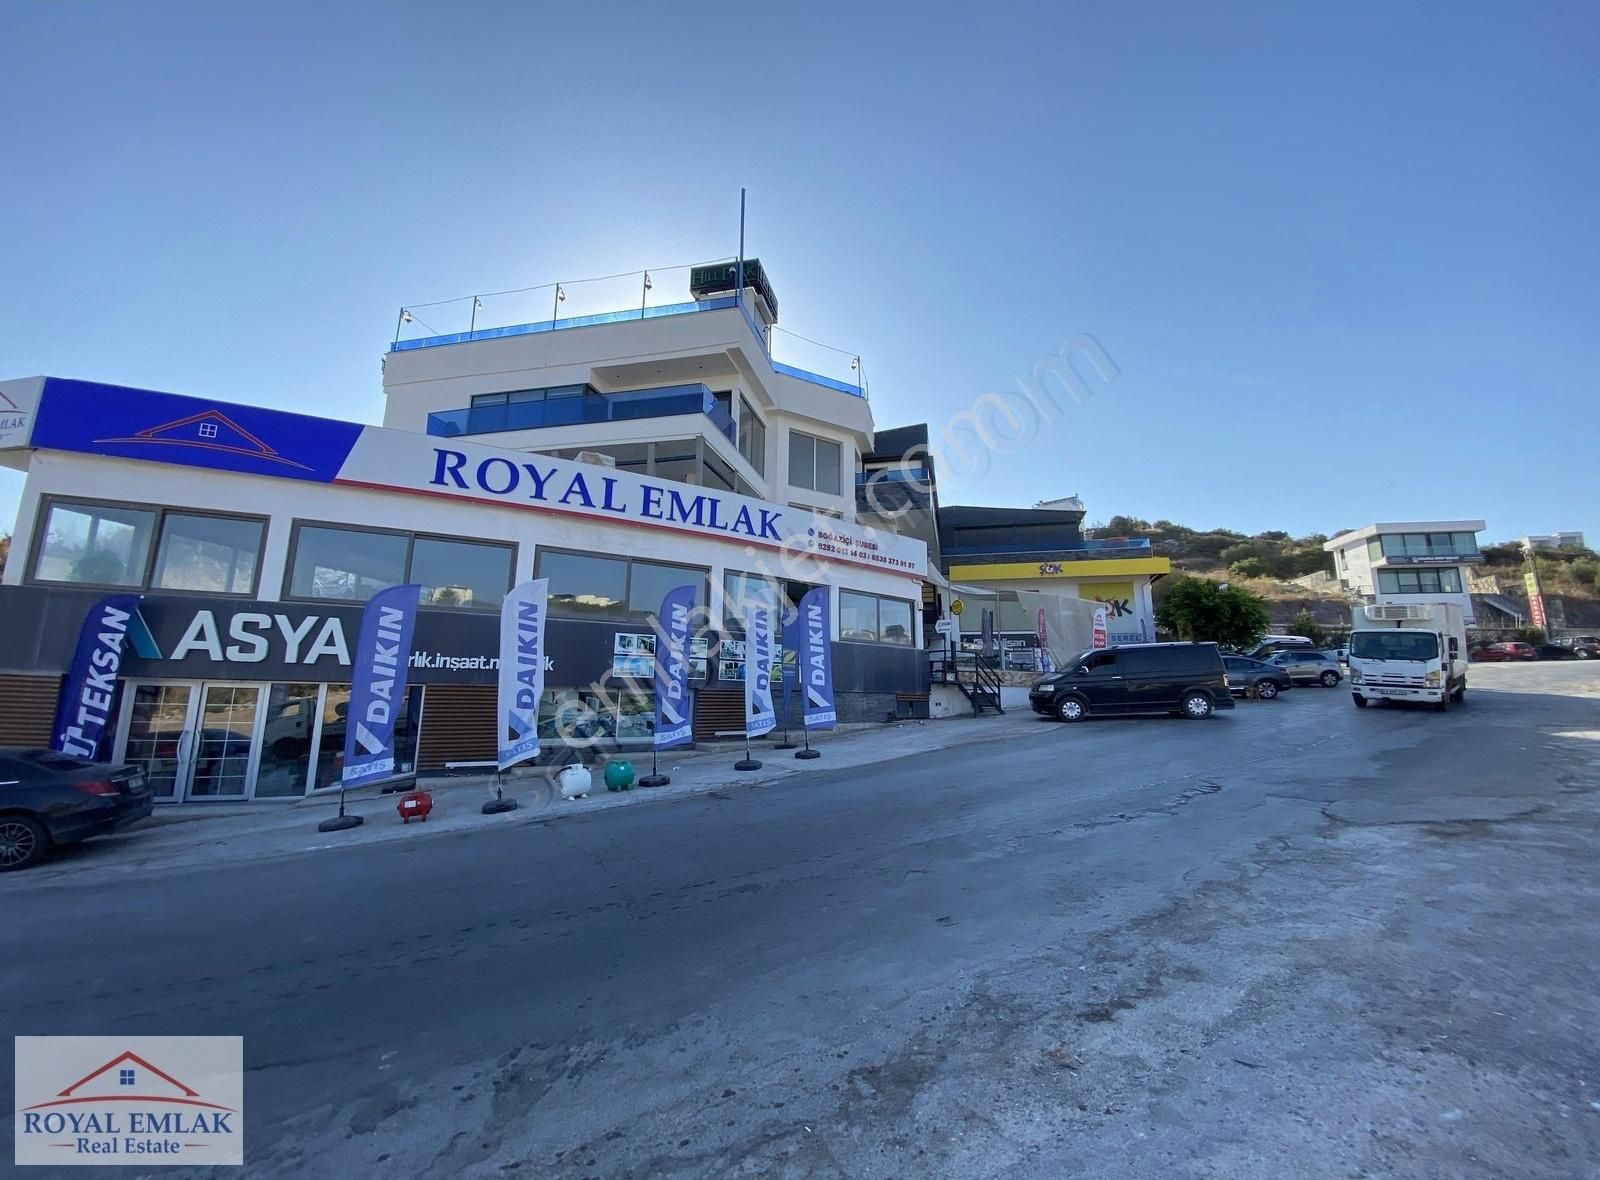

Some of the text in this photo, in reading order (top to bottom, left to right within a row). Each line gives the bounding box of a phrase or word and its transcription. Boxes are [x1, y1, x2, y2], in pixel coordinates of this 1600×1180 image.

[429, 448, 783, 542] ROYAL EMLAK
[818, 542, 836, 553] 0252
[77, 605, 131, 726] TEKSAN
[170, 610, 351, 666] ASYA
[366, 606, 404, 724] DAIKIN
[516, 600, 539, 709] DAIKIN
[667, 602, 688, 700] DAIKIN
[755, 604, 770, 691] DAIKIN
[808, 604, 825, 686] DAIKIN
